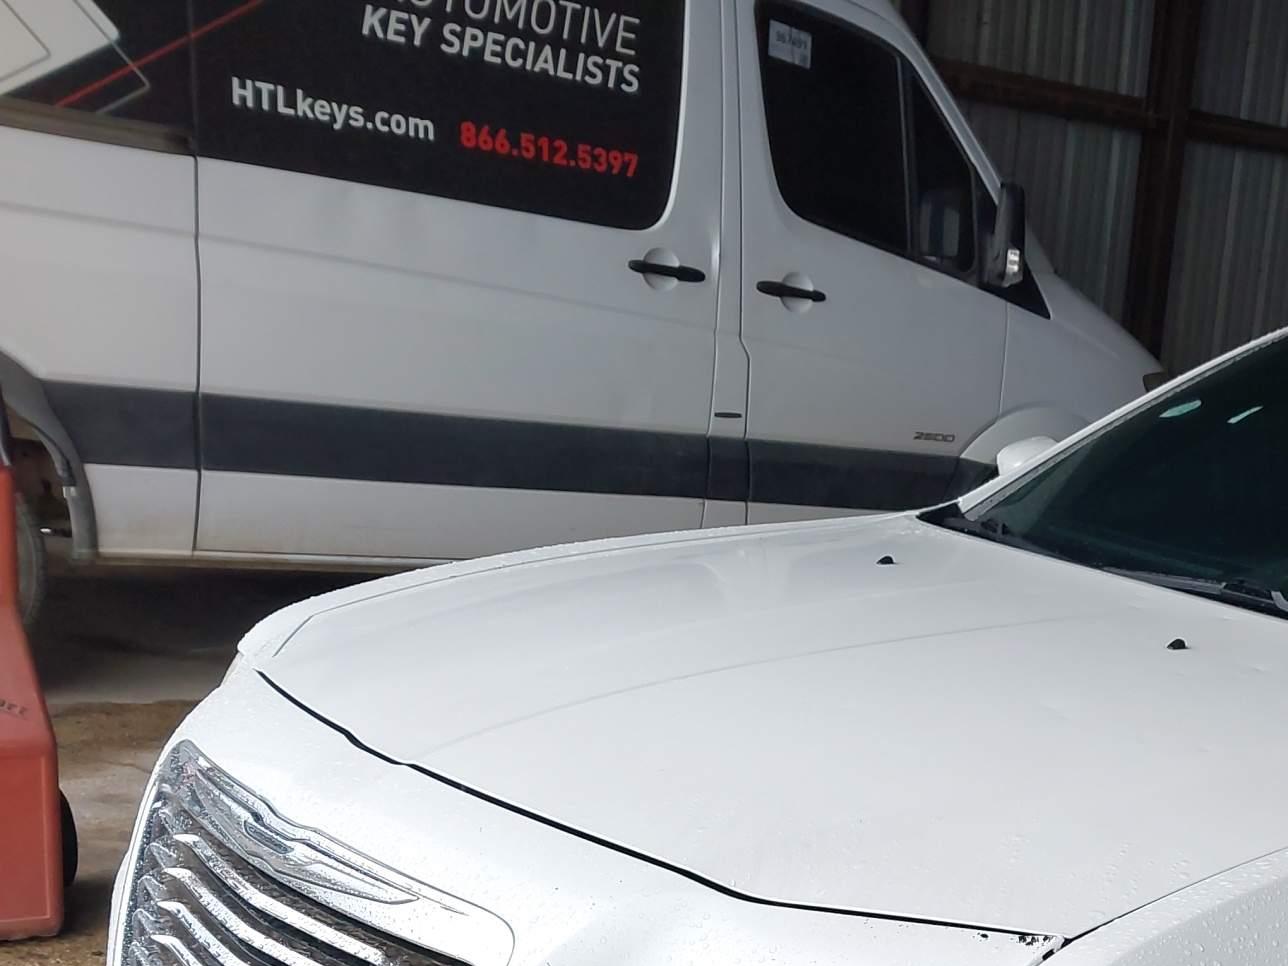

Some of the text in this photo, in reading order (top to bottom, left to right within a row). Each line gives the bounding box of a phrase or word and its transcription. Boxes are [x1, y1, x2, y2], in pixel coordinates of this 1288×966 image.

[361, 4, 641, 94] KEY SPECIALISTS
[399, 0, 641, 56] OMOTIVE
[231, 76, 639, 178] HTLkeys.com 866.512.5397
